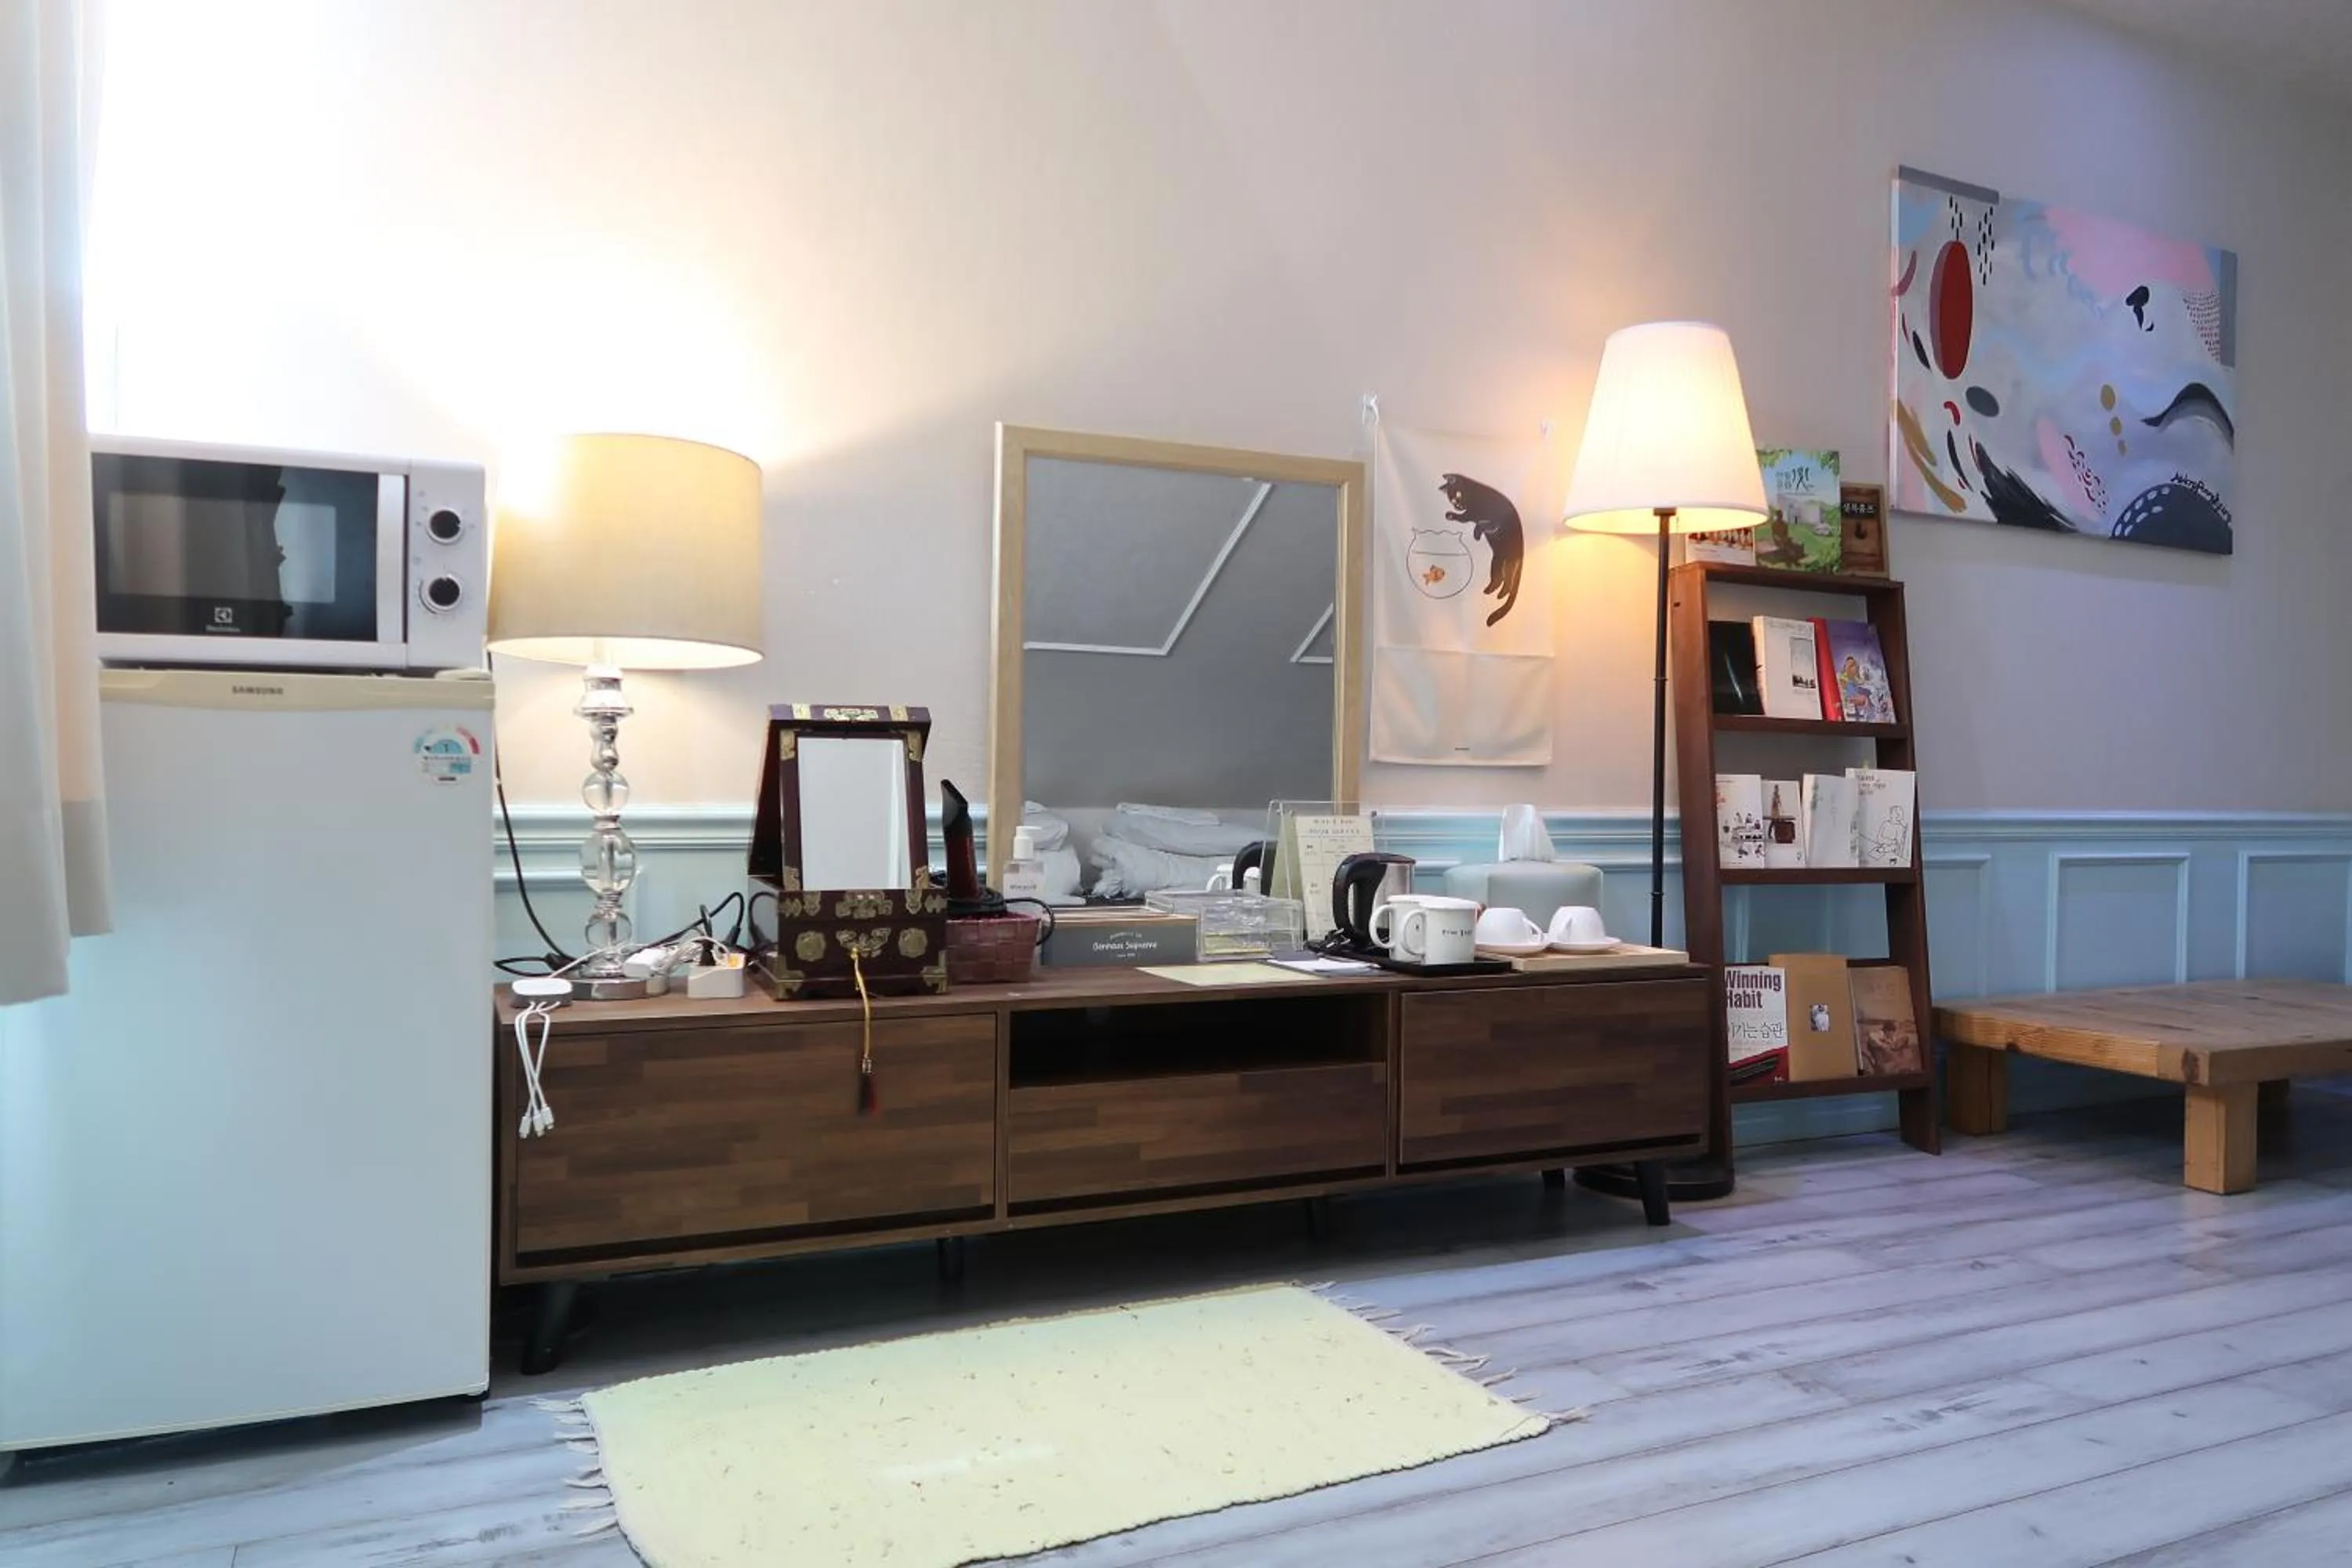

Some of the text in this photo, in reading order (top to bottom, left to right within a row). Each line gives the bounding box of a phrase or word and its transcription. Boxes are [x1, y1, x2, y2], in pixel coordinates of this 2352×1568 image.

[1726, 970, 1781, 992] Winning
[1726, 989, 1762, 1008] Habit
[1760, 1022, 1784, 1039] 습관
